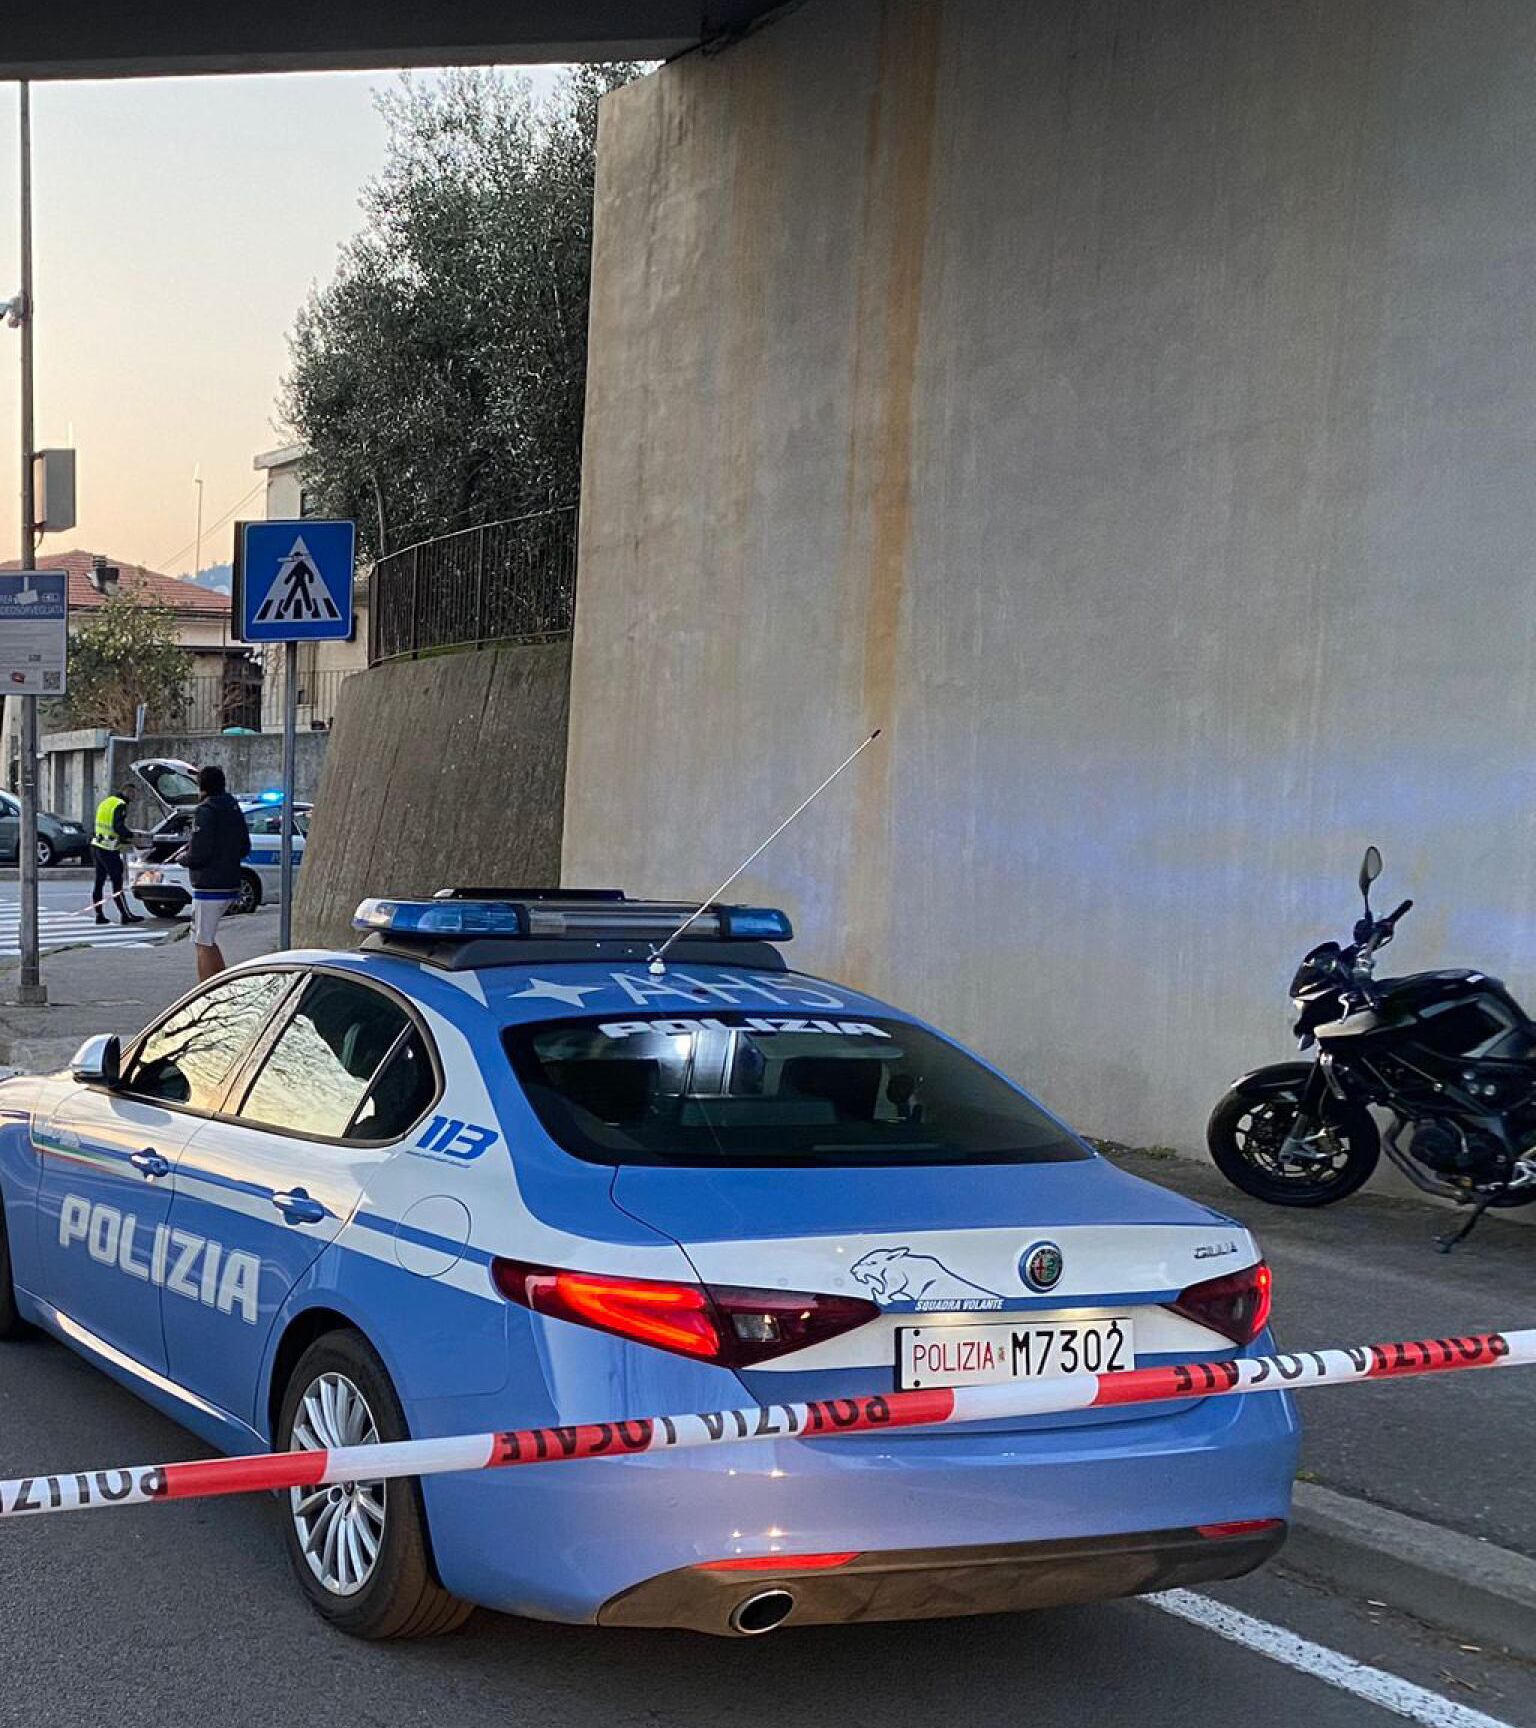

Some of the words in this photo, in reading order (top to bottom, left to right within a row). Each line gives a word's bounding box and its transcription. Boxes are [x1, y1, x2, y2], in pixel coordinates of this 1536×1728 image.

[597, 1017, 892, 1038] POLIZIA
[415, 1116, 498, 1161] 113
[59, 1193, 261, 1325] POLIZIA
[915, 1299, 961, 1311] SQUADRA
[963, 1299, 1004, 1310] VOLANTE
[912, 1340, 996, 1374] POLIZIA
[1010, 1329, 1126, 1376] M7302
